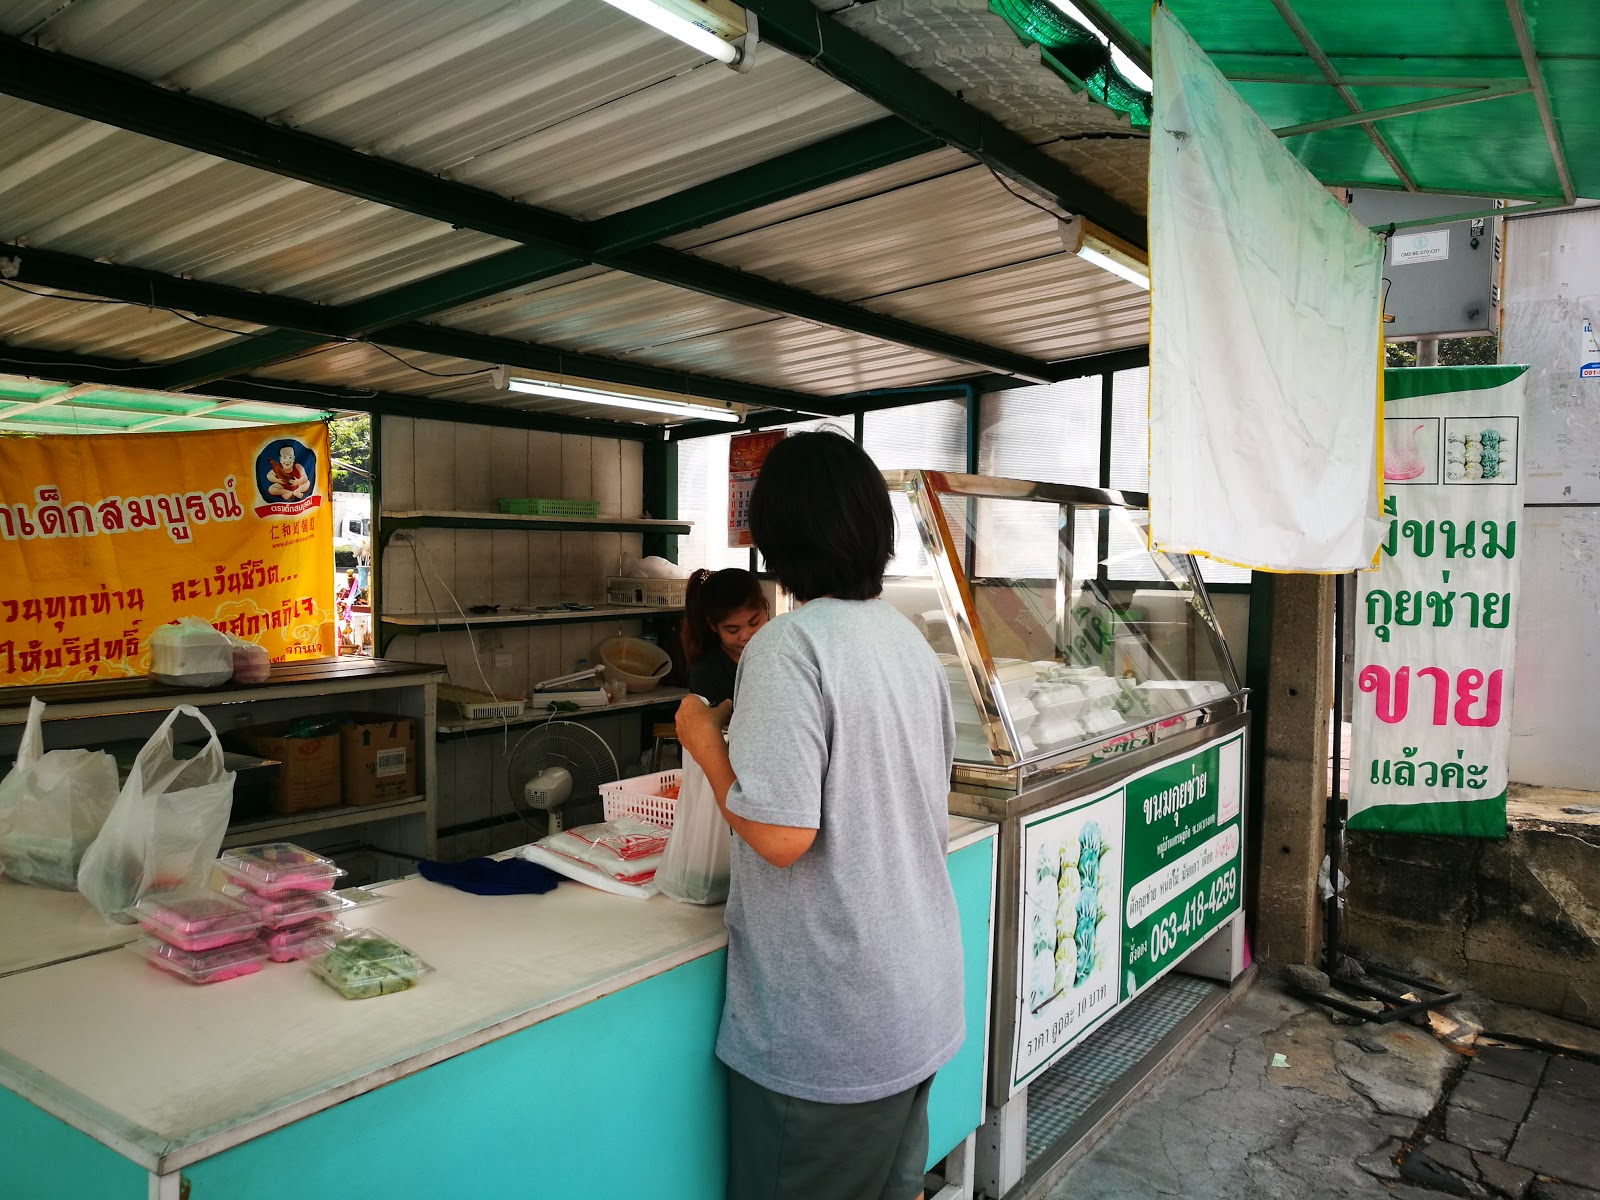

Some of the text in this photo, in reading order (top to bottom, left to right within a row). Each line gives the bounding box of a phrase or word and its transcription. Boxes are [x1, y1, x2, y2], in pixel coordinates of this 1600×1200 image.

[2, 583, 145, 633] วนทุกท่าน
[1365, 570, 1511, 643] กุยช่าย
[1358, 664, 1503, 728] ขาย
[1143, 763, 1207, 827] ขนมกุยช่าย
[1370, 746, 1488, 790] แล้วค่ะ
[1150, 866, 1236, 963] 063-418-4259
[1027, 1028, 1049, 1056] ราคา
[1078, 996, 1087, 1018] 10
[1089, 984, 1107, 1008] บาท
